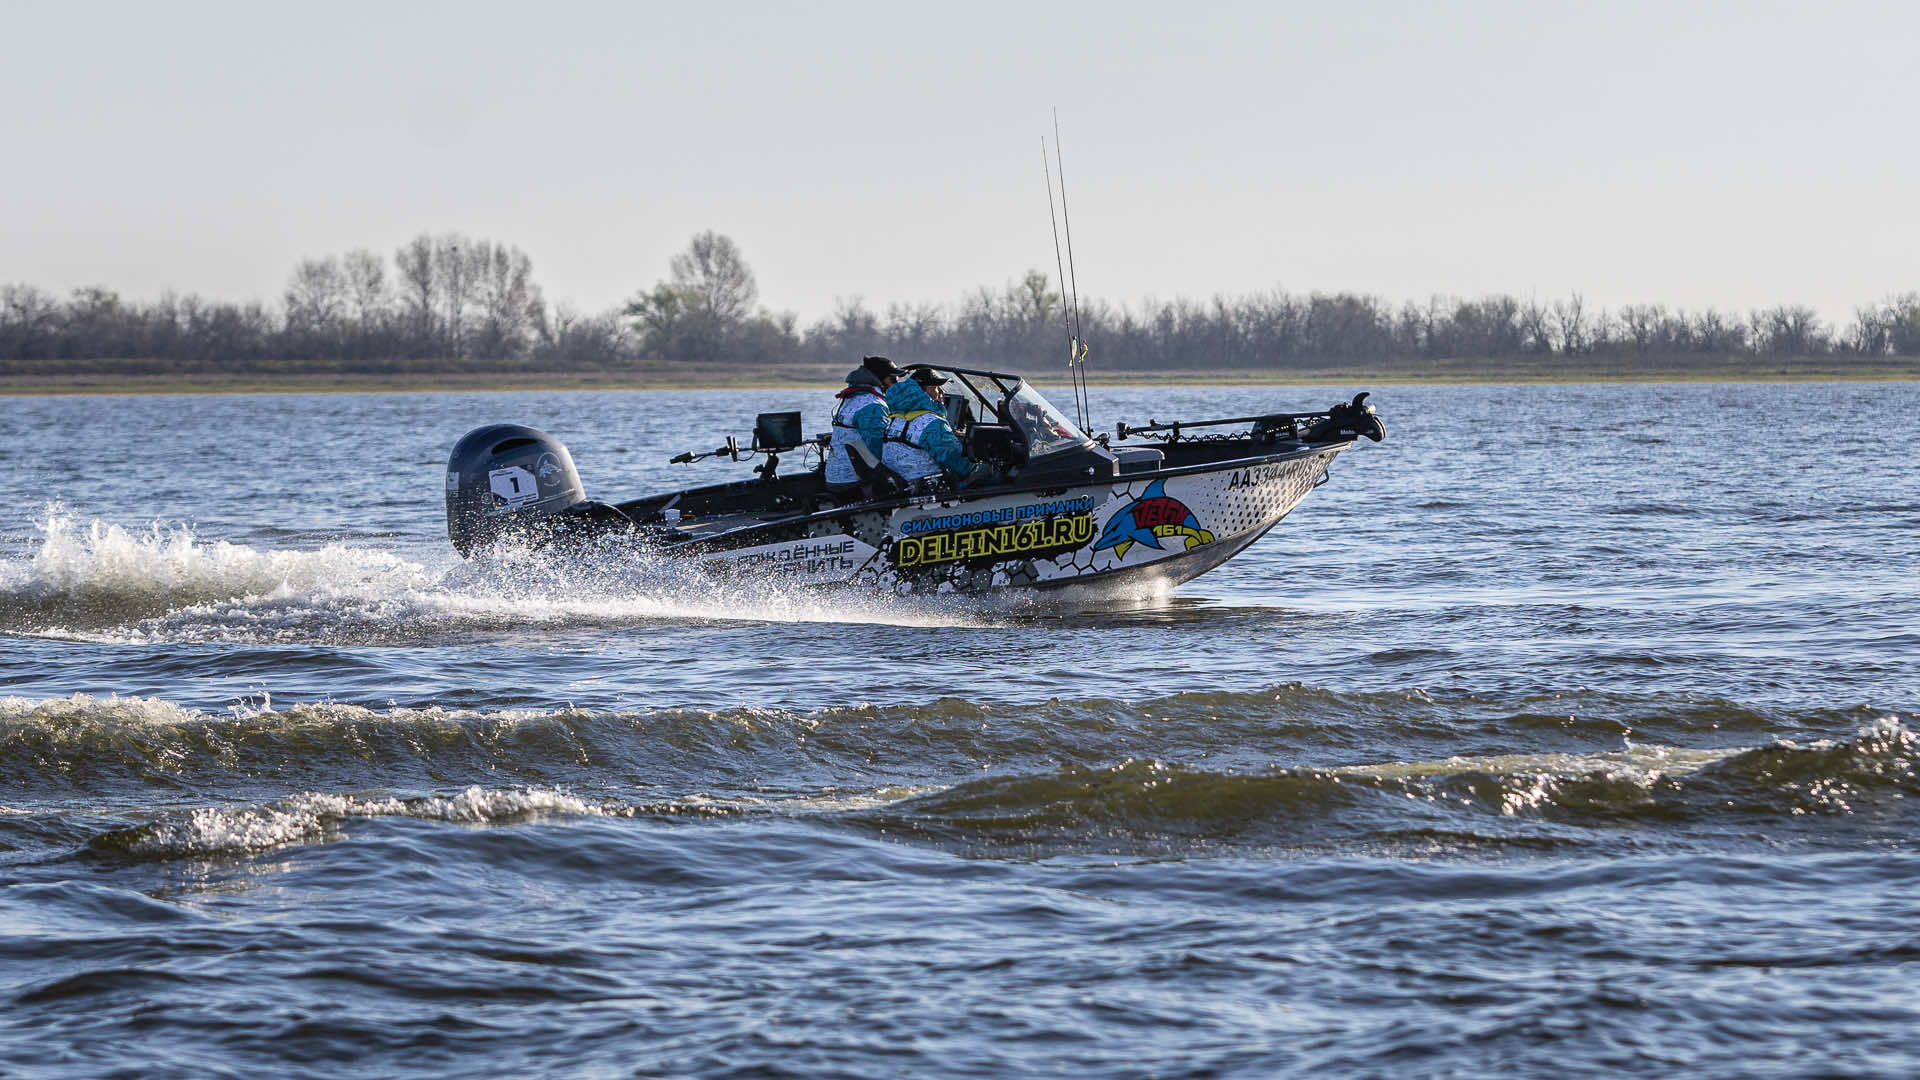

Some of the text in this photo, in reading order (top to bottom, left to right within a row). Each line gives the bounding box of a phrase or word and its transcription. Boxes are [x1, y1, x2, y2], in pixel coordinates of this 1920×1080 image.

[510, 477, 520, 493] 1
[901, 496, 1095, 534] СИЛИКОНОВЫЕ ПРИМАНКИ
[900, 514, 1093, 566] DELFIN161.RU
[1153, 525, 1183, 537] 161
